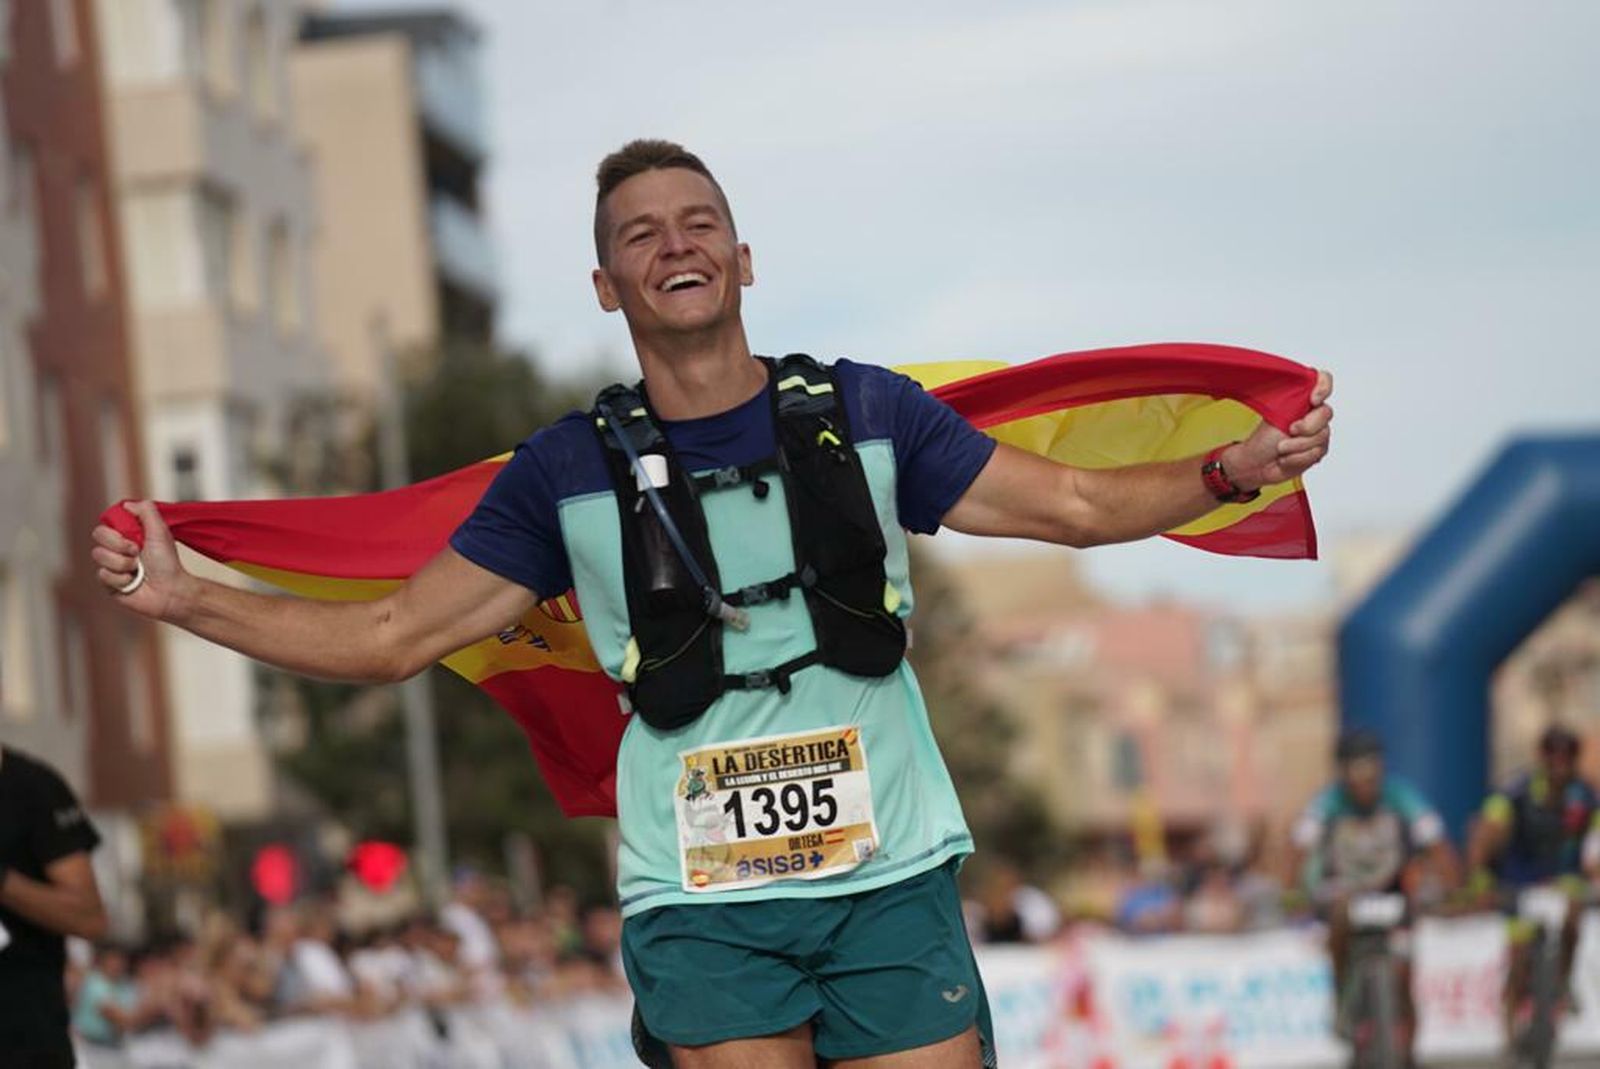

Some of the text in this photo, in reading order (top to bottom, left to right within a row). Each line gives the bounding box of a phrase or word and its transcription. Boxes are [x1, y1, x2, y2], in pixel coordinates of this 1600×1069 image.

[712, 755, 739, 775] LA
[723, 778, 838, 838] 1395
[736, 852, 805, 878] asisa
